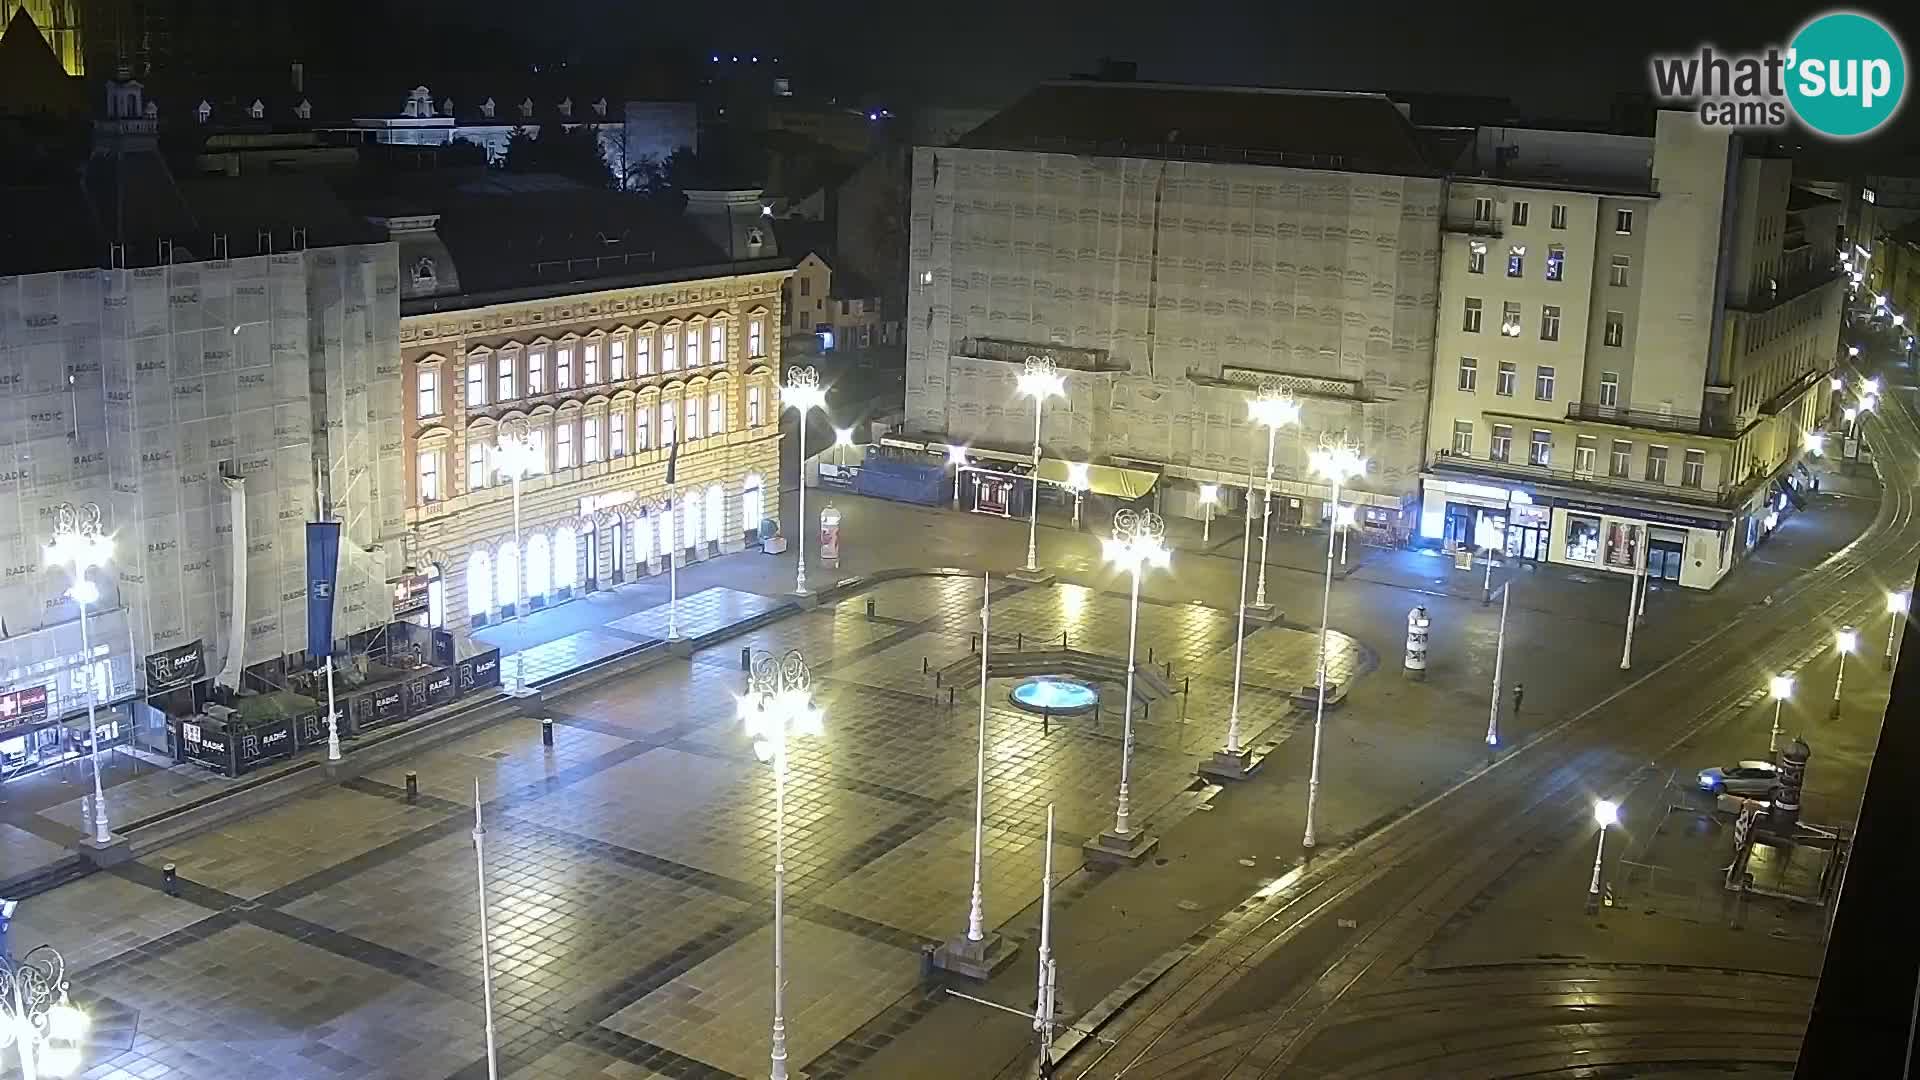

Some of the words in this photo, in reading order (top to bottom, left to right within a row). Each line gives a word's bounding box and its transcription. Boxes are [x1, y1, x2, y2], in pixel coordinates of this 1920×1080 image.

[153, 656, 173, 681] R
[460, 664, 474, 688] R
[304, 715, 320, 739] R
[243, 735, 260, 759] R
